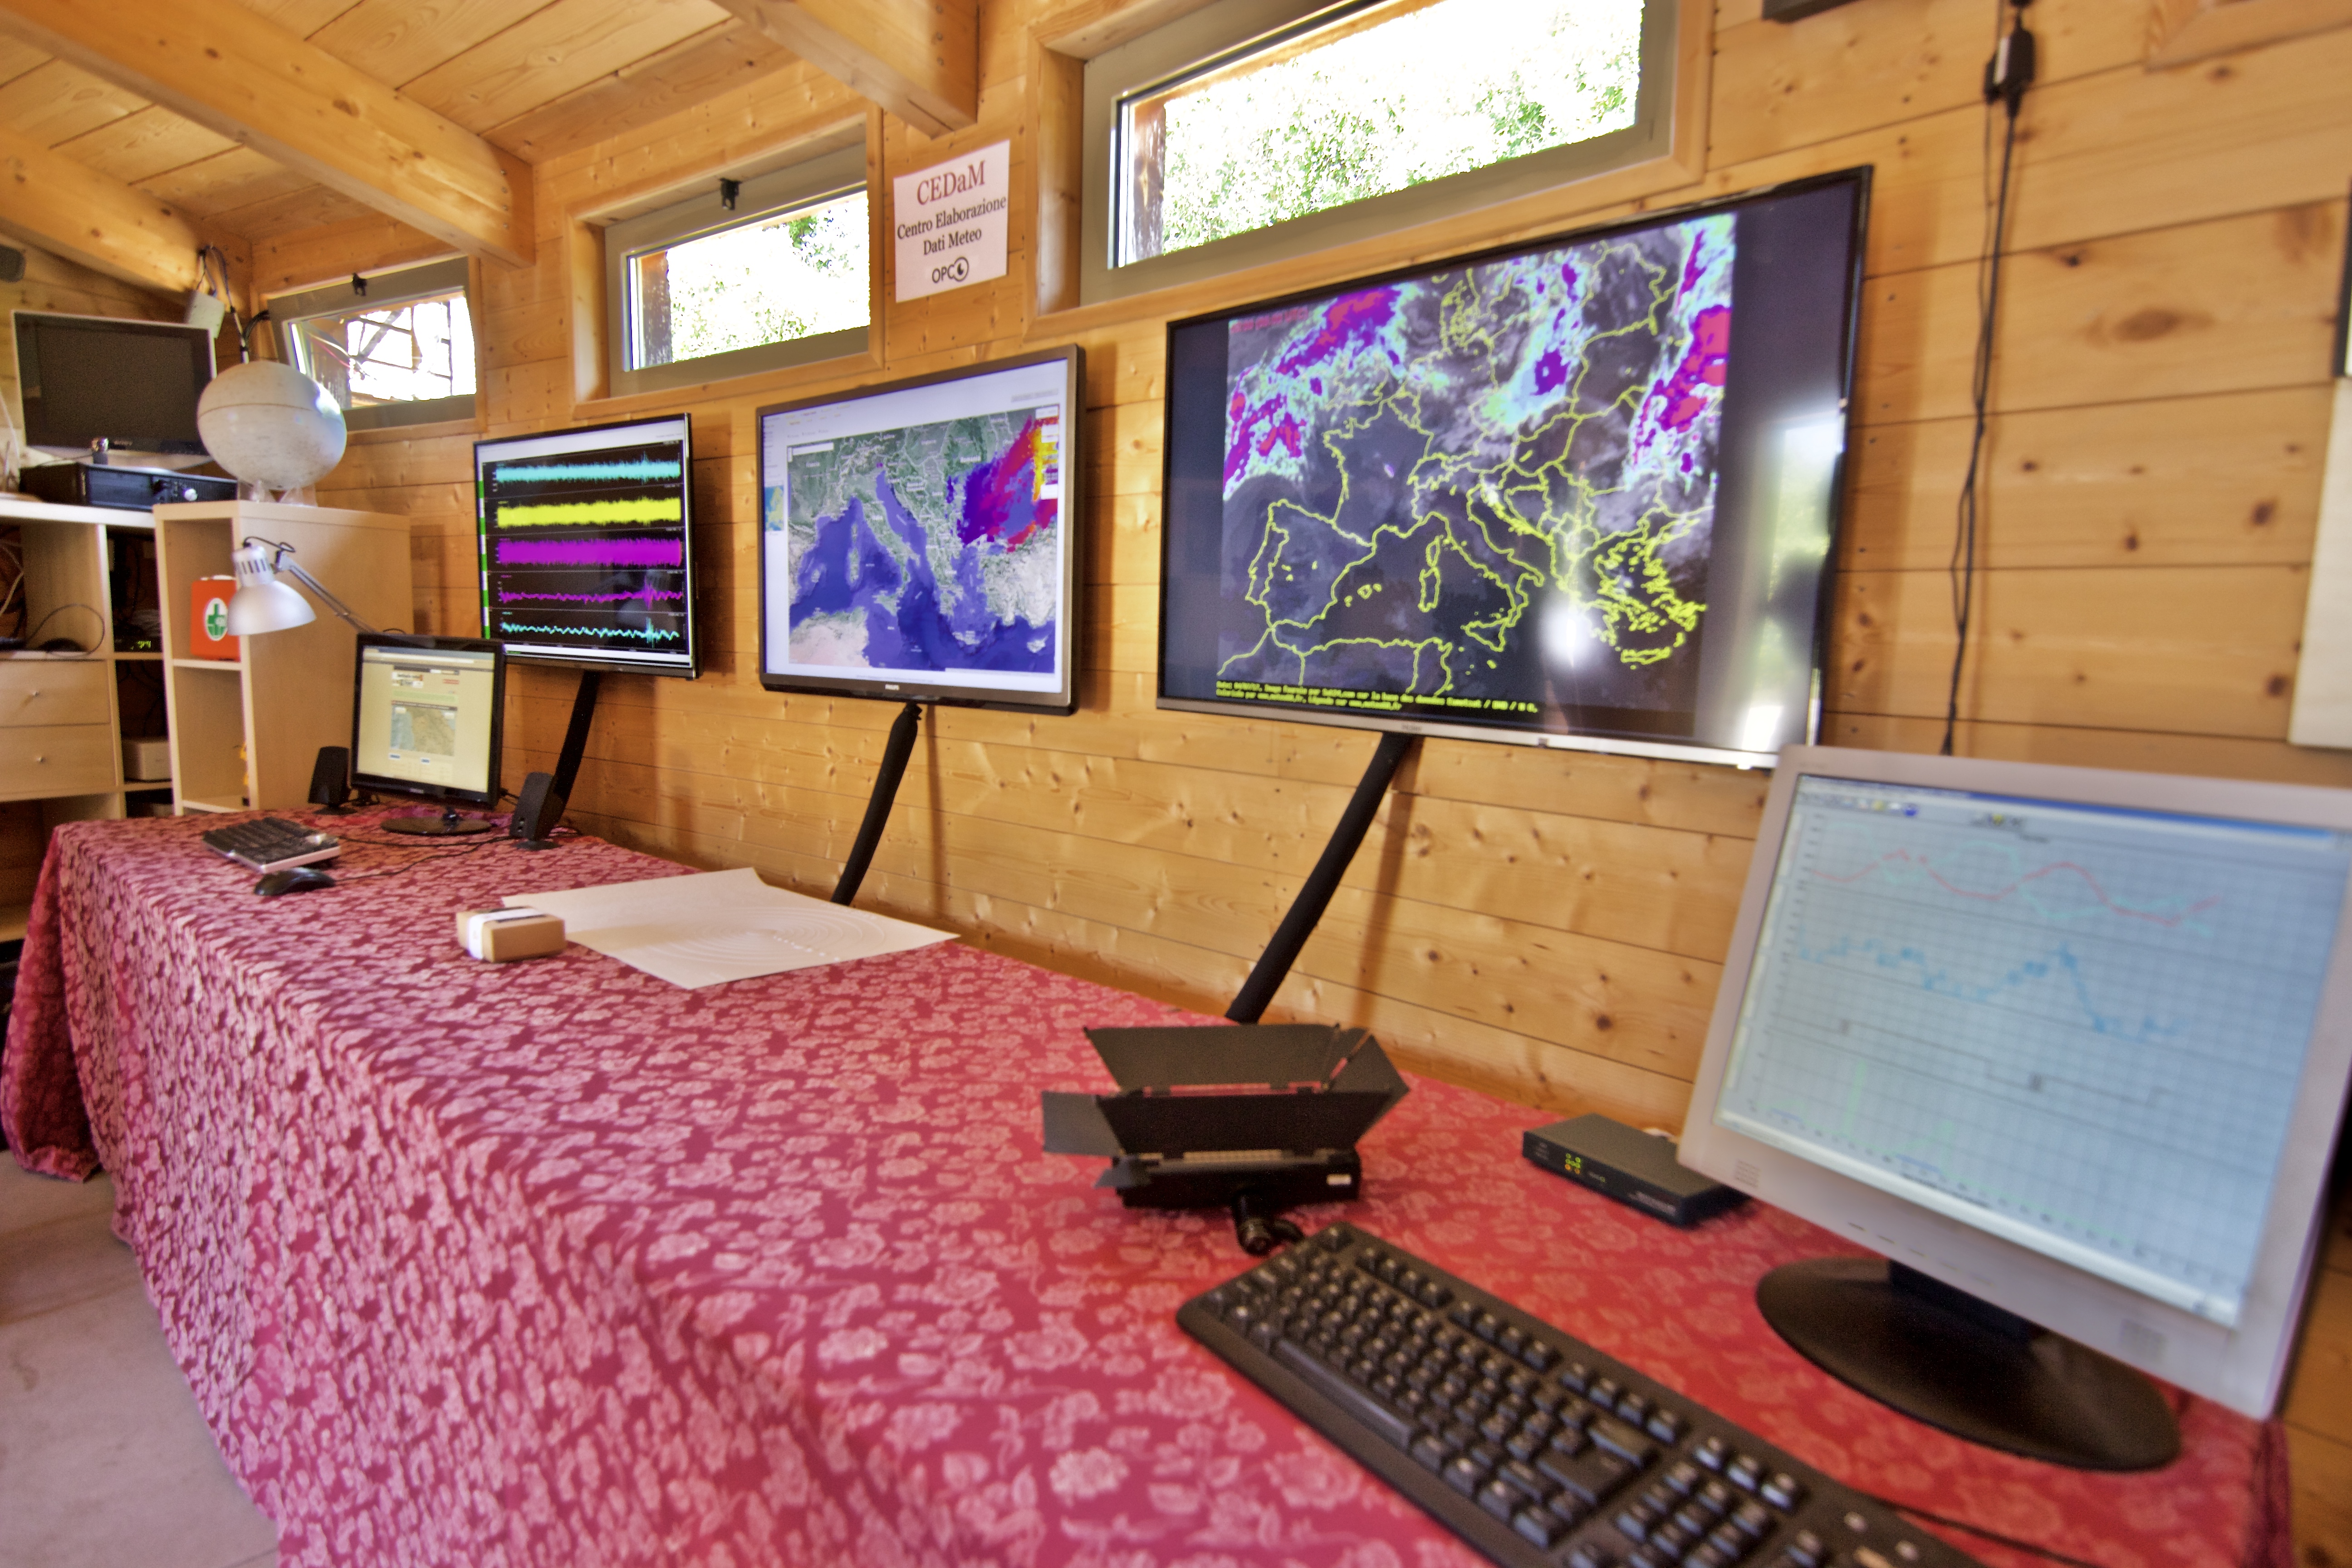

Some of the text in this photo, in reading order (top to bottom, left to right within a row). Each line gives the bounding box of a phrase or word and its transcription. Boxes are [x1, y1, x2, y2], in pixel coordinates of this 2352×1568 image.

[917, 160, 985, 205] CEDaM
[897, 196, 1006, 240] Centro Elaborazione
[923, 227, 981, 255] Dati Meteo
